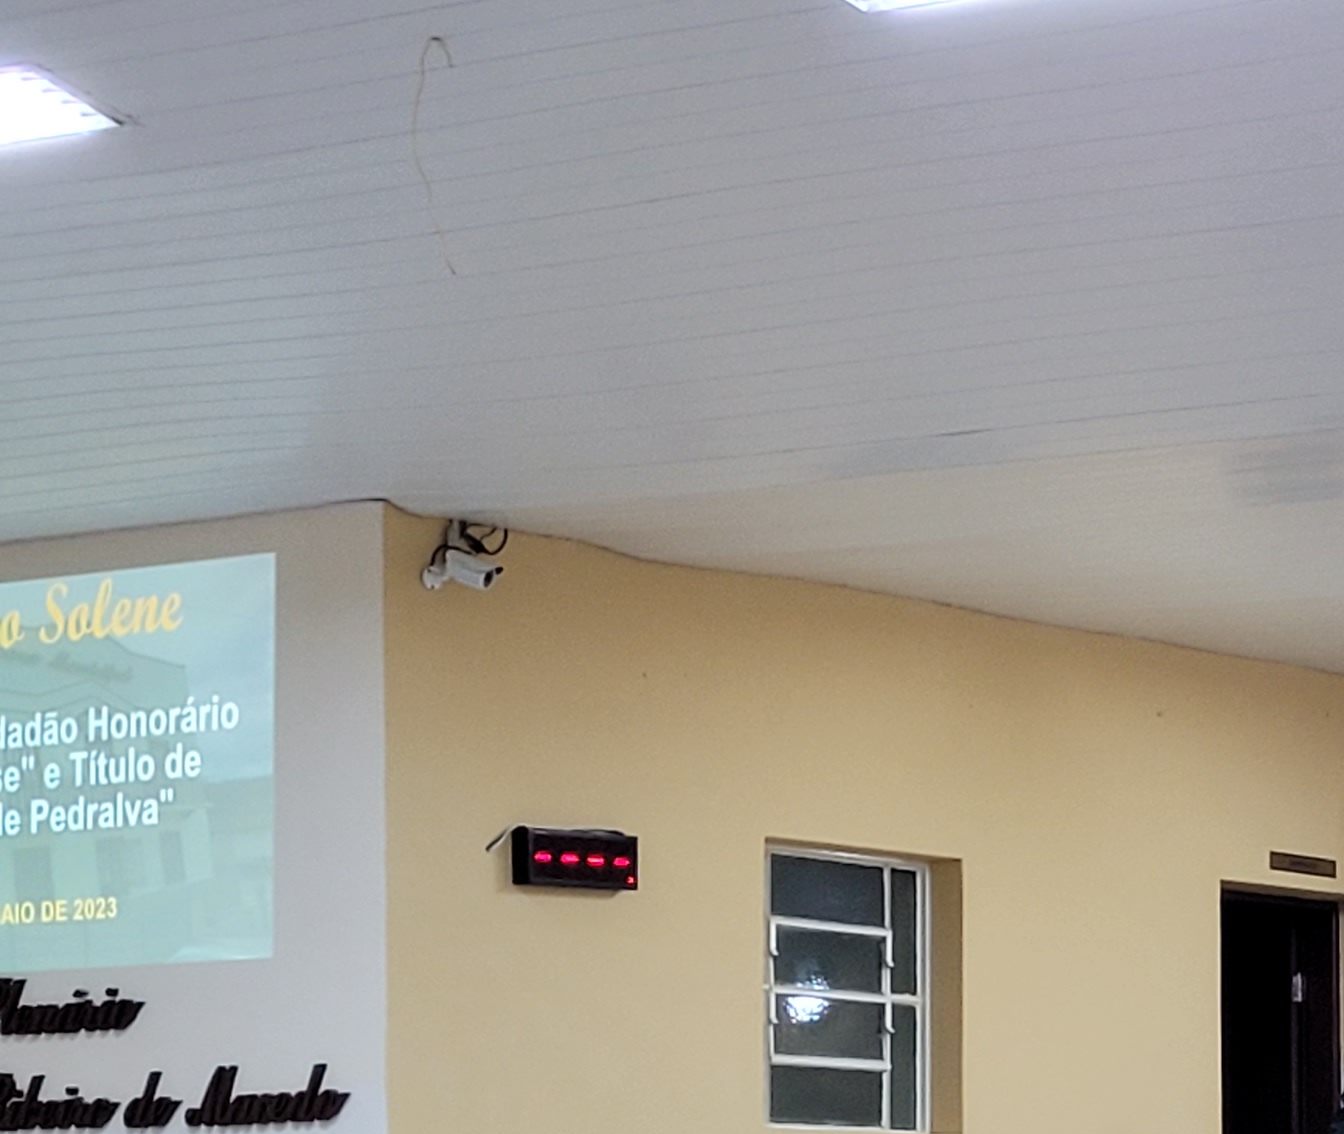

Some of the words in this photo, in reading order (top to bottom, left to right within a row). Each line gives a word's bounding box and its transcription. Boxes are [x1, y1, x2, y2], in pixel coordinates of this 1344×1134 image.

[39, 578, 184, 644] Solene
[87, 694, 240, 742] Honorário
[43, 762, 61, 789] e
[69, 746, 155, 787] Título
[164, 742, 201, 779] de
[30, 787, 174, 834] Pedralva"
[41, 900, 68, 923] DE
[73, 896, 118, 921] 2023
